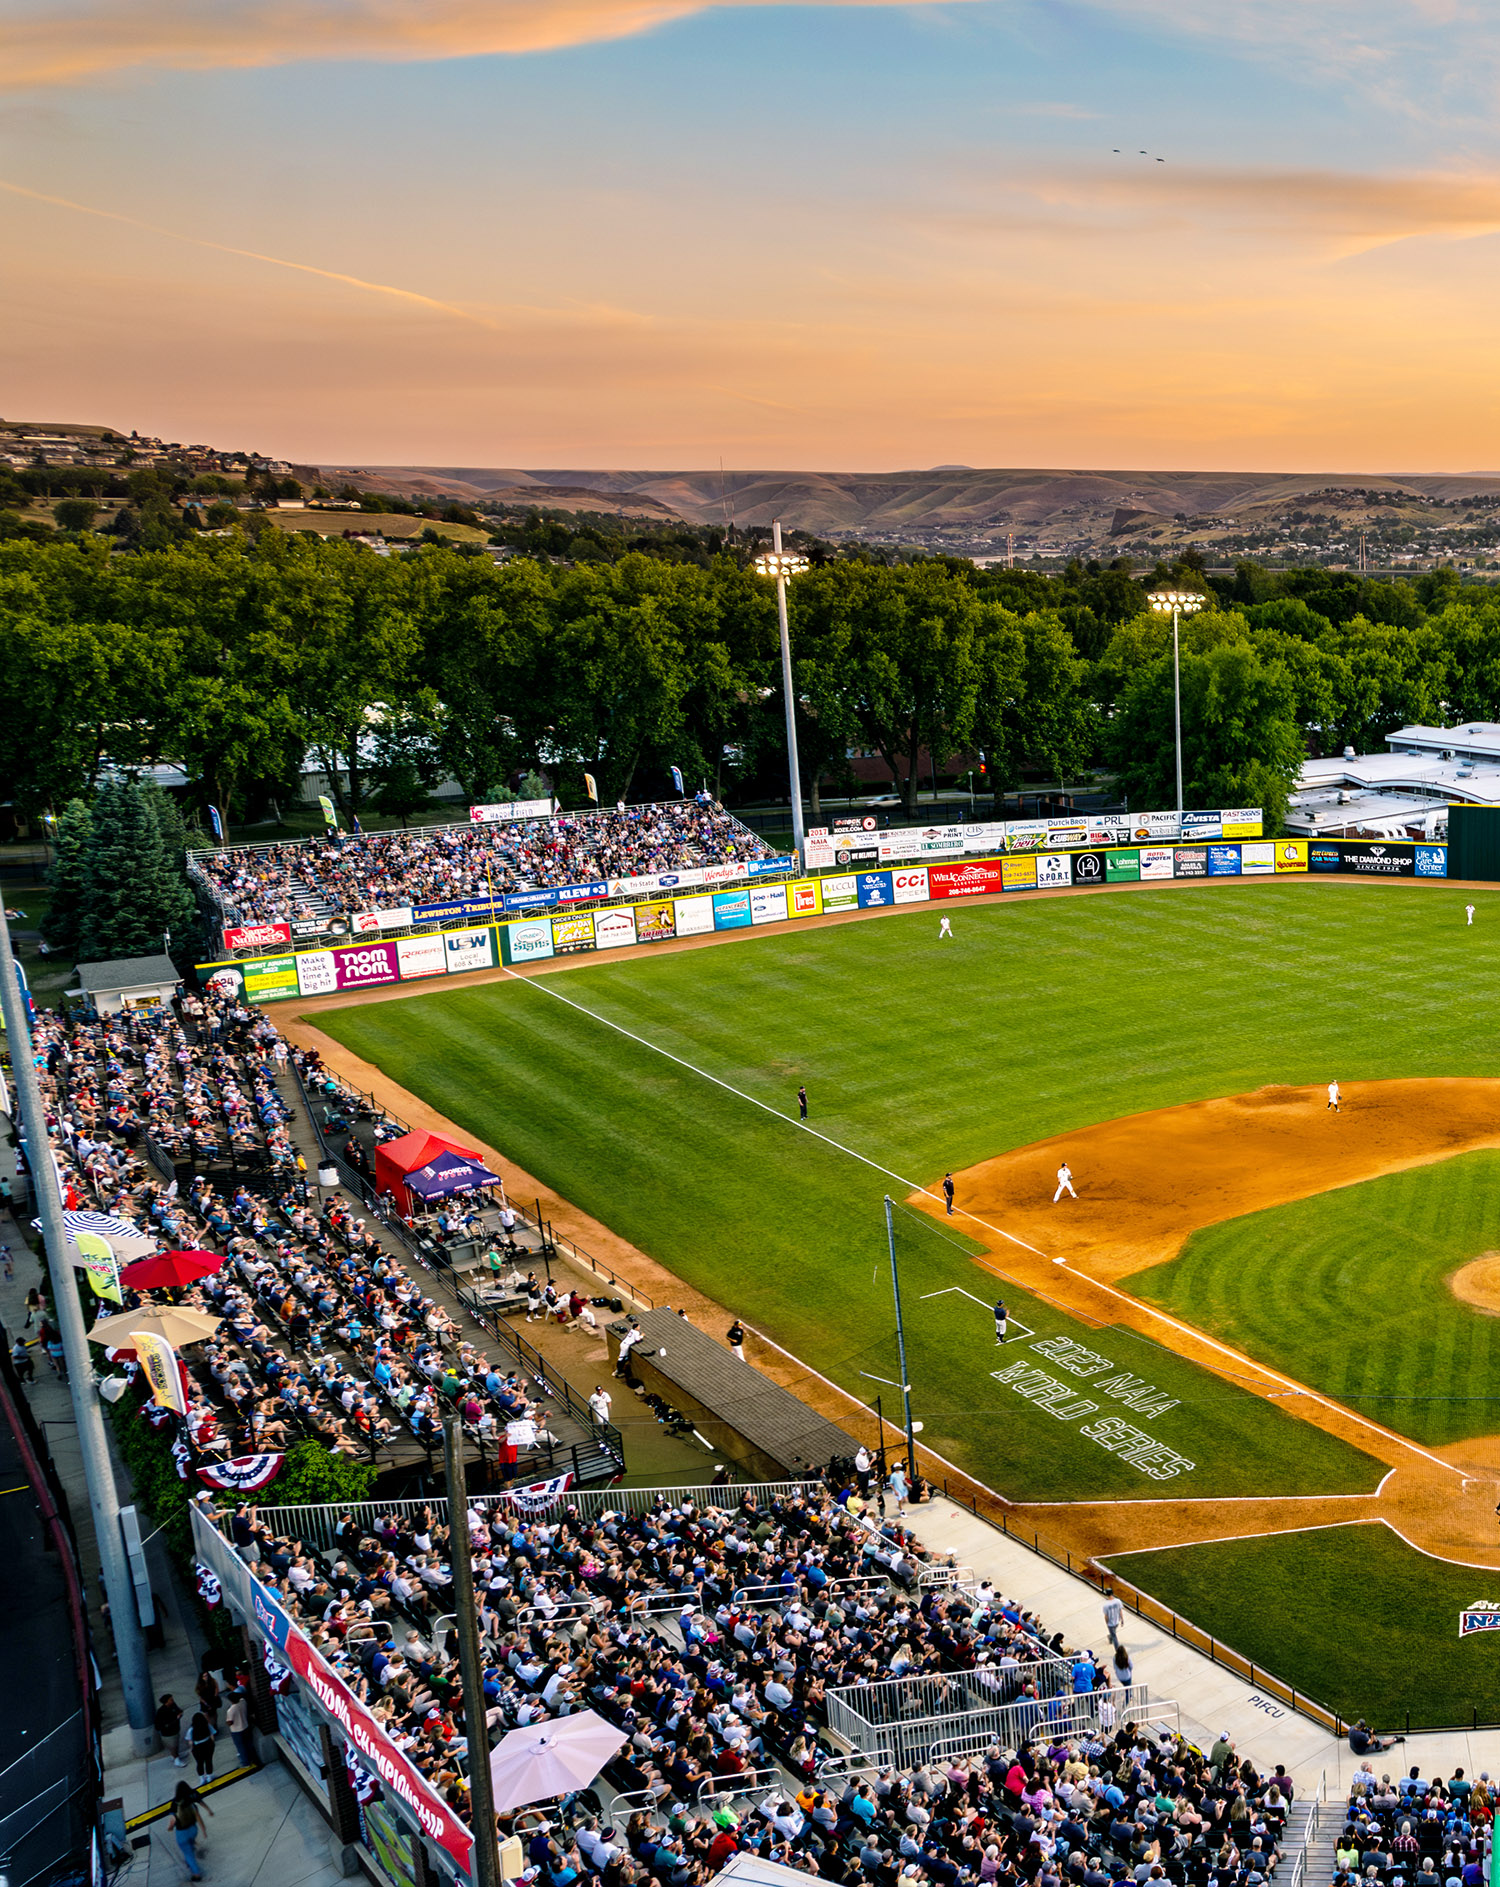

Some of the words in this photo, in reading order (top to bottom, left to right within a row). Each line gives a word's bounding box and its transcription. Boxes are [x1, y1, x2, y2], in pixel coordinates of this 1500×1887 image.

[1048, 819, 1069, 827] DUTCH
[1104, 815, 1124, 826] PRL
[1151, 814, 1177, 822] PACIFIC
[1182, 813, 1220, 823] AVISTA
[810, 828, 827, 837] 2017
[1050, 833, 1086, 843] SUBWAY
[930, 840, 964, 849] SOMBRERO
[1416, 850, 1429, 859] Life
[1344, 855, 1358, 863] THE
[1359, 855, 1391, 864] DIAMOND
[1392, 858, 1412, 866] SHOP
[1418, 863, 1443, 871] Center
[559, 887, 590, 900] KLEW
[599, 885, 606, 895] 3
[769, 891, 785, 900] Hall
[413, 906, 462, 919] LEWISTON
[463, 902, 503, 912] TRIBUNE
[448, 935, 486, 951] USW
[513, 939, 550, 952] Signs
[340, 949, 387, 966] nom
[401, 947, 443, 959] ROGERS
[460, 952, 479, 961] Local
[301, 956, 325, 965] Make
[302, 963, 327, 973] snack
[345, 961, 392, 978] nom
[302, 972, 323, 981] time
[304, 981, 318, 990] big
[320, 979, 332, 987] hit
[1029, 1336, 1115, 1377] 2023
[1092, 1371, 1182, 1419] NAIA
[989, 1360, 1100, 1420] WORLD
[1079, 1416, 1197, 1480] SERIES
[352, 1722, 445, 1840] CHAMPIONSHIP
